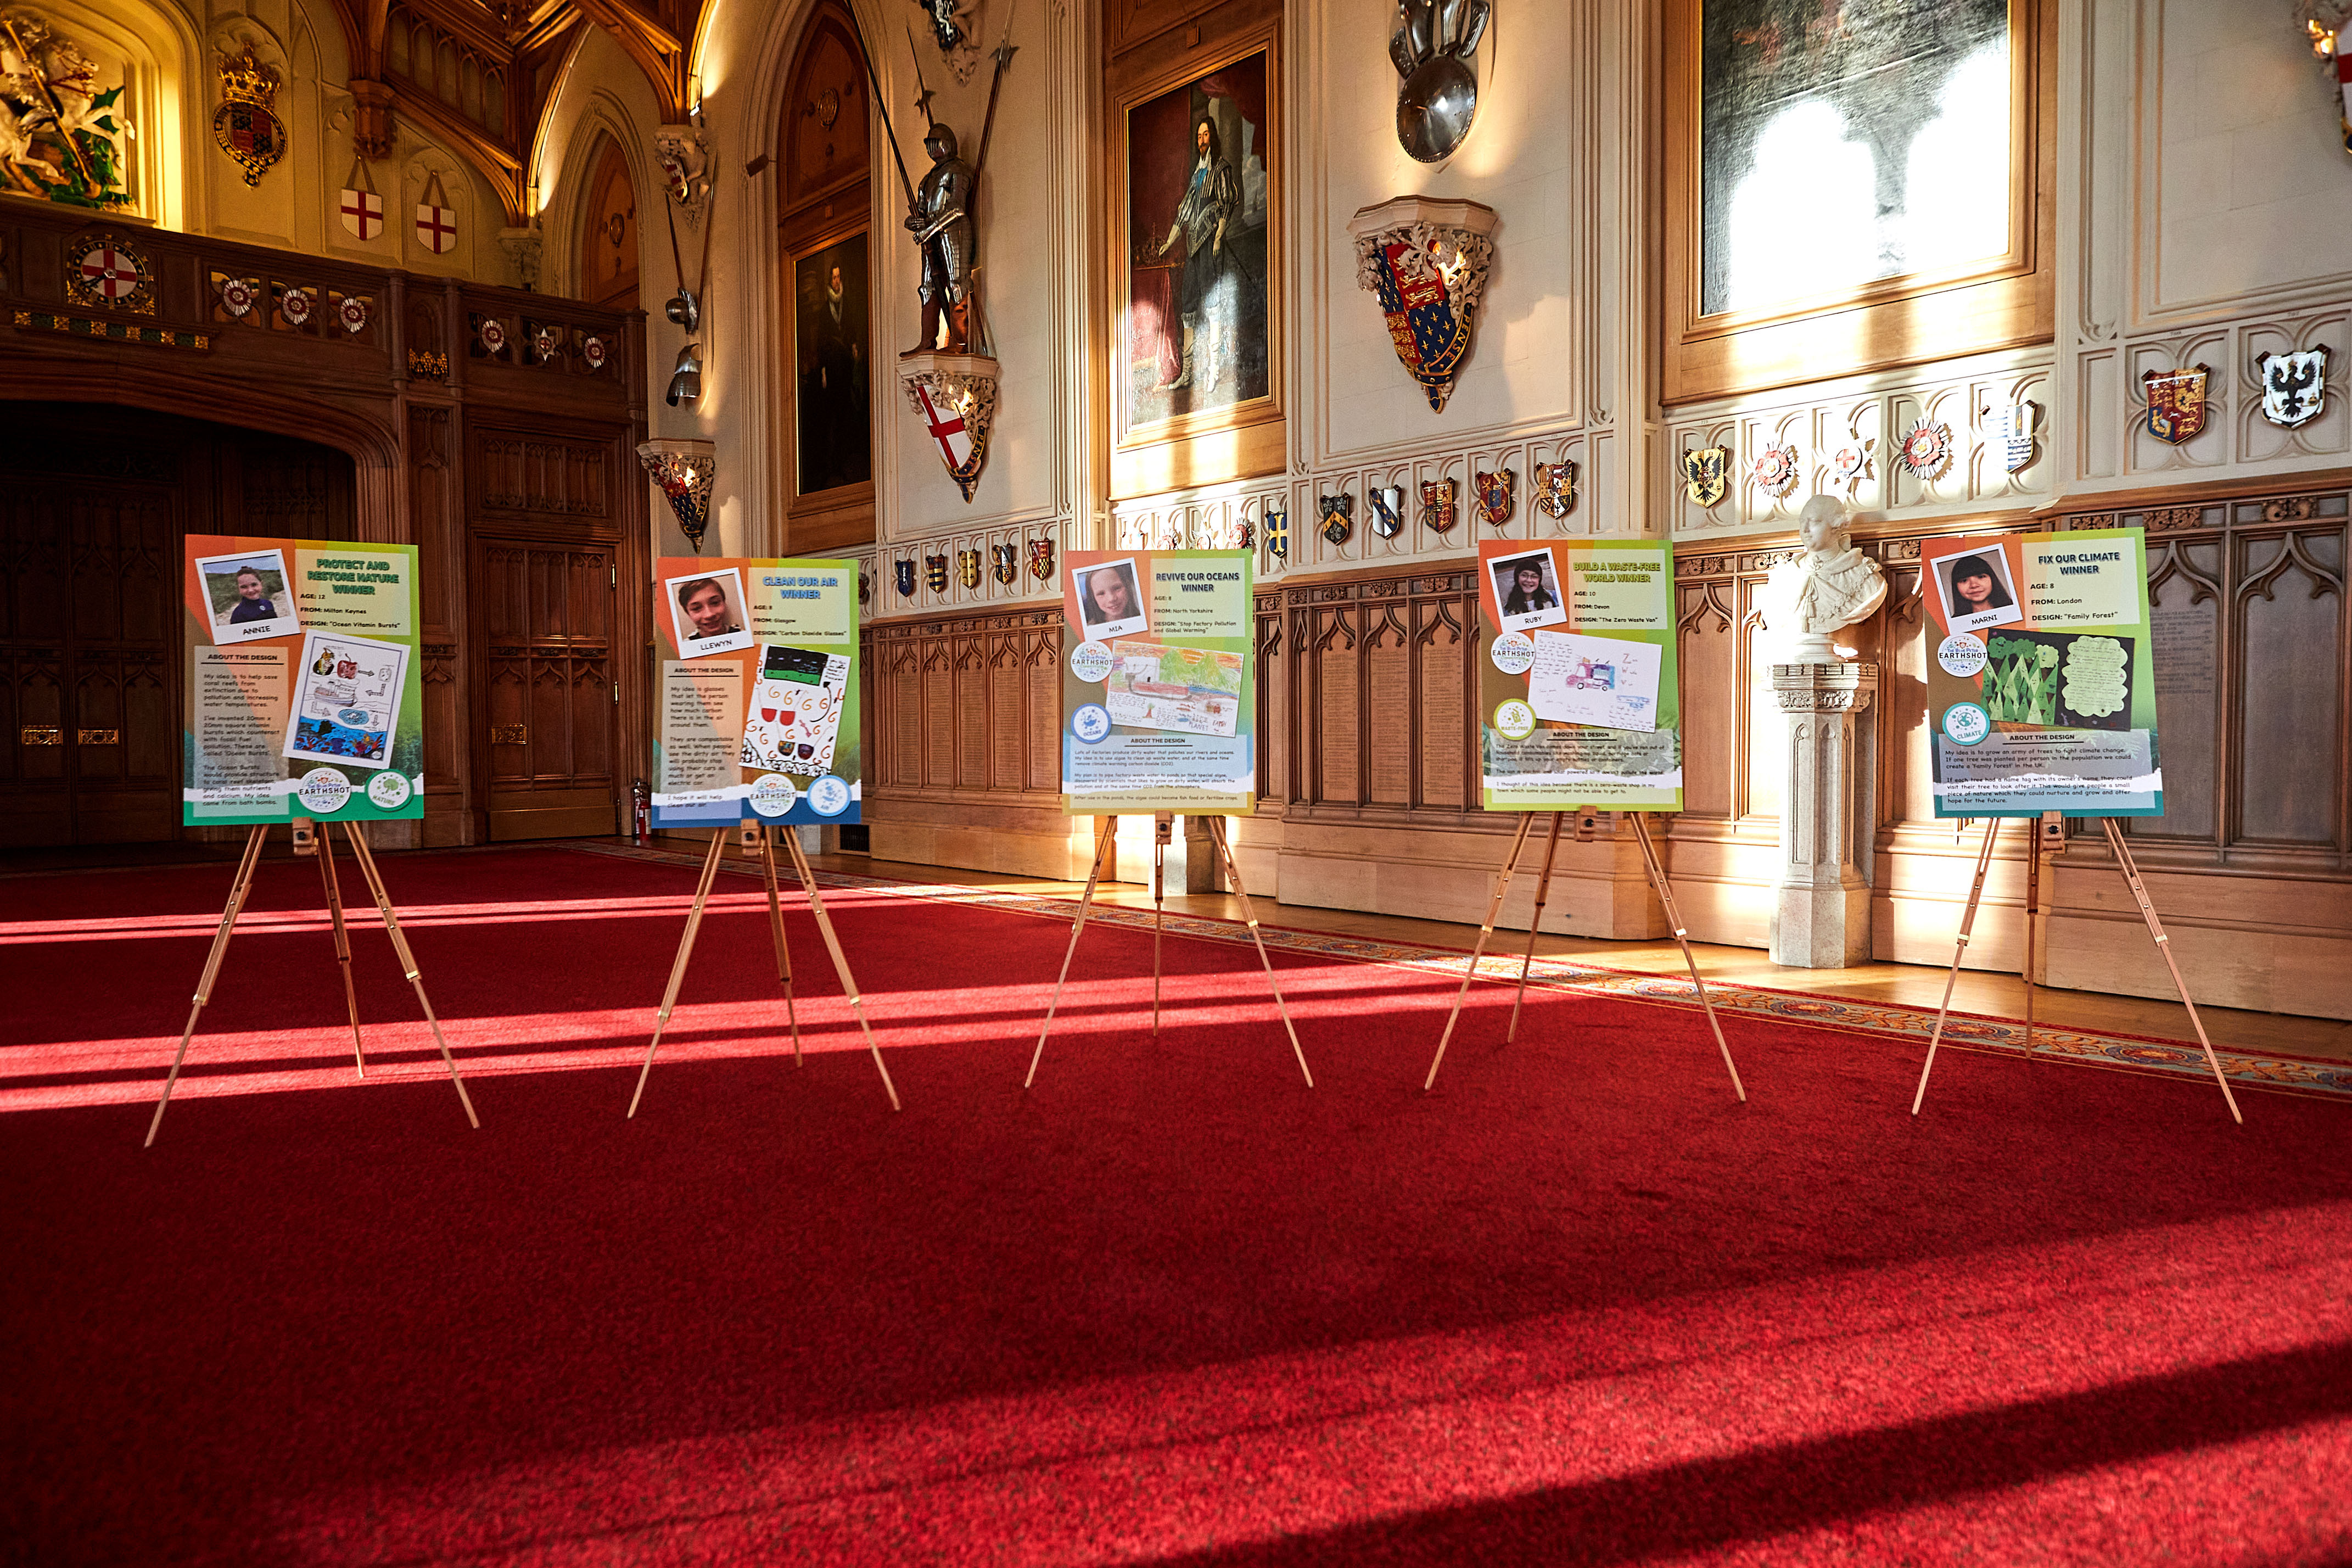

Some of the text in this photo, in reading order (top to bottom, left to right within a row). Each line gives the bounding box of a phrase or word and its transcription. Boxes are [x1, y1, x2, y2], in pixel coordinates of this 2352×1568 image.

[1445, 312, 1471, 360] PENSE
[968, 434, 984, 467] PENSE
[2039, 552, 2120, 564] FIX OUR CLIMATE
[317, 559, 390, 570] PROTECT AND
[1573, 562, 1660, 571] BUILD A WASTE-FREE
[2060, 565, 2099, 575] WINNER
[307, 571, 399, 583] RESTORE NATURE
[763, 576, 837, 586] CLEAN OUR AIR
[1617, 574, 1650, 583] WINNER
[333, 584, 375, 595] WINNER
[780, 590, 820, 599] WINNER
[1972, 614, 1997, 625] MARNI
[243, 626, 271, 635] ANNIE
[701, 640, 732, 650] LLEWYN
[1957, 730, 1982, 739] CLIMATE
[299, 787, 350, 795] EARTHSHOT
[372, 795, 395, 805] NATURE
